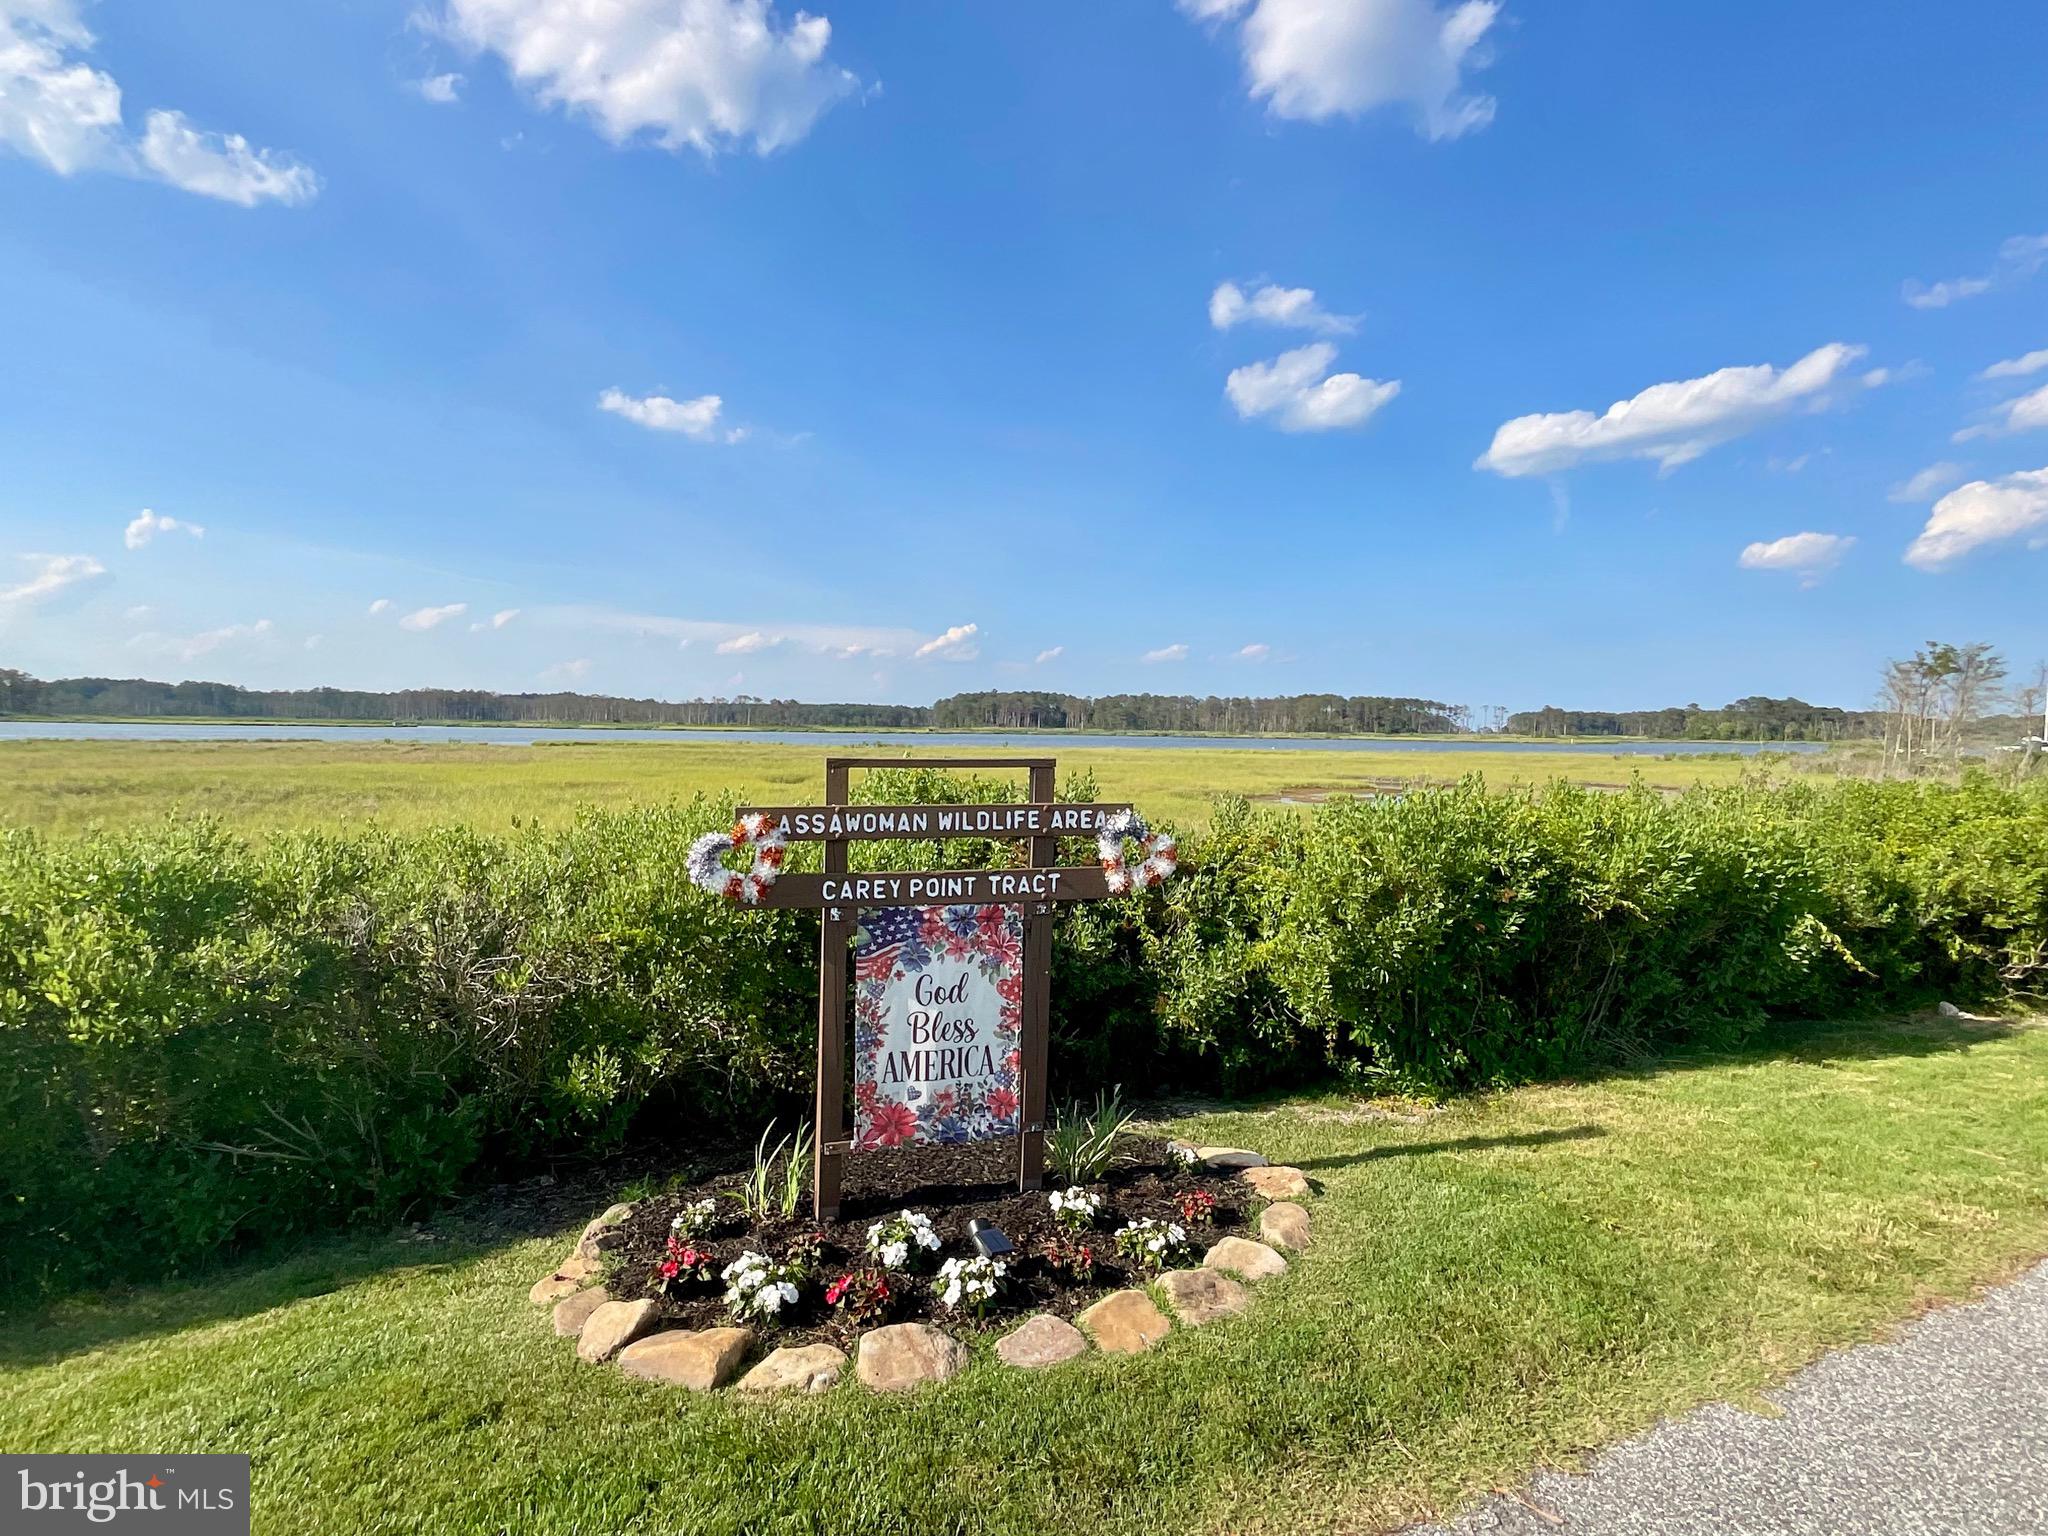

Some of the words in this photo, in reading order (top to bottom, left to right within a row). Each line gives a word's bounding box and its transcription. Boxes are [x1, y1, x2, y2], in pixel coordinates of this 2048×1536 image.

[780, 812, 929, 835] ASSAWOMAN
[937, 810, 1041, 832] WILDLIFE
[1051, 810, 1105, 830] AREA
[822, 877, 900, 901] CAREY
[909, 875, 976, 898] POINT
[988, 873, 1061, 895] TRACT
[915, 972, 970, 1007] God
[906, 1011, 980, 1045] Bless
[881, 1044, 996, 1084] AMERICA
